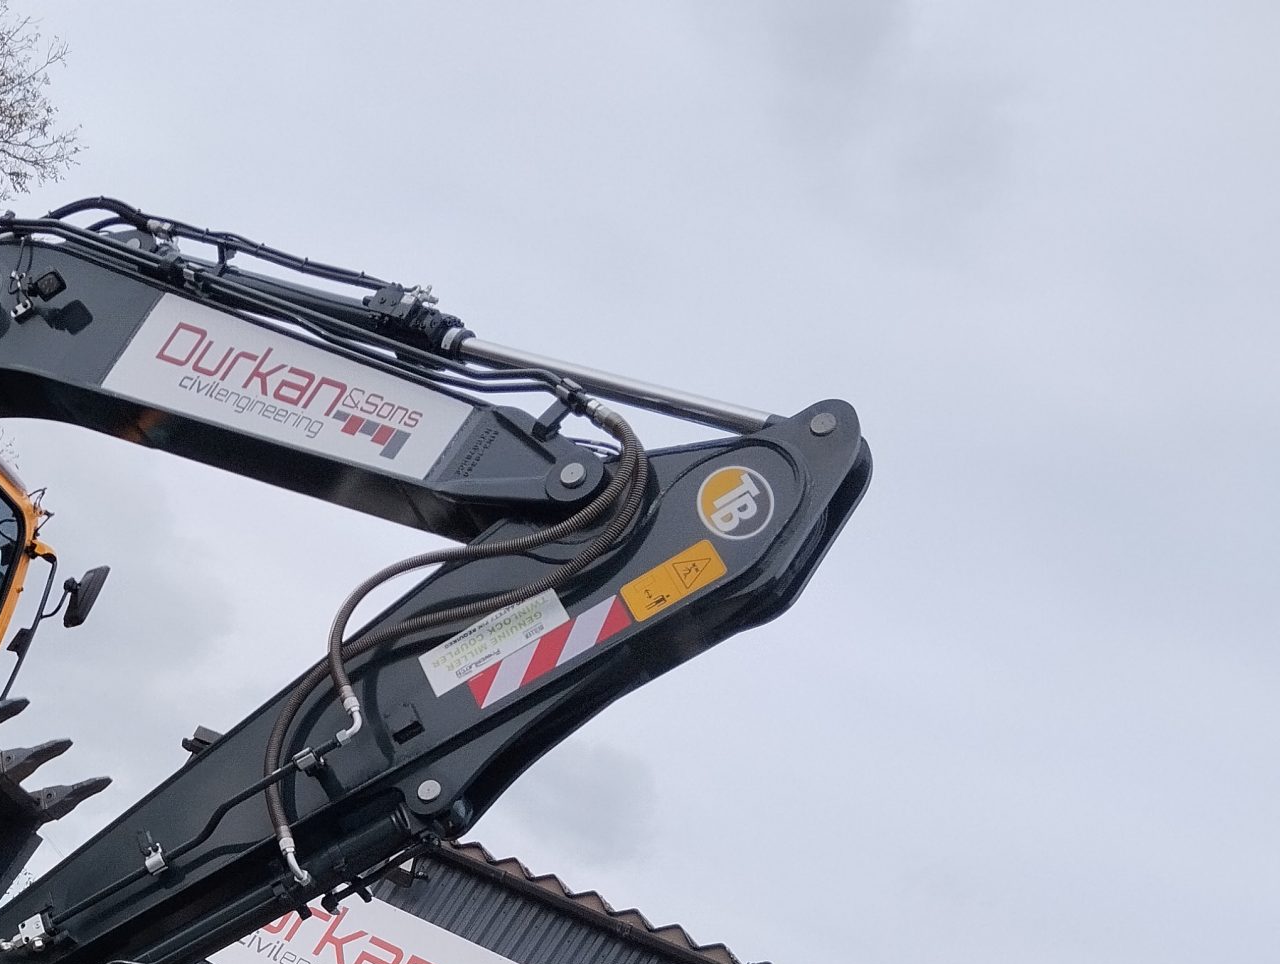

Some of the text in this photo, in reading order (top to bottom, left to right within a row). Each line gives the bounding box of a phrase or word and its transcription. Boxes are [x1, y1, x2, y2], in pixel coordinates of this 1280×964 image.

[155, 322, 348, 417] Durkan
[178, 374, 324, 438] civilengineering
[710, 473, 760, 532] TB
[432, 594, 548, 668] TWINLOCK COUPLER
[444, 628, 477, 649] REQUIRED
[447, 611, 543, 672] GENUINE MILLER
